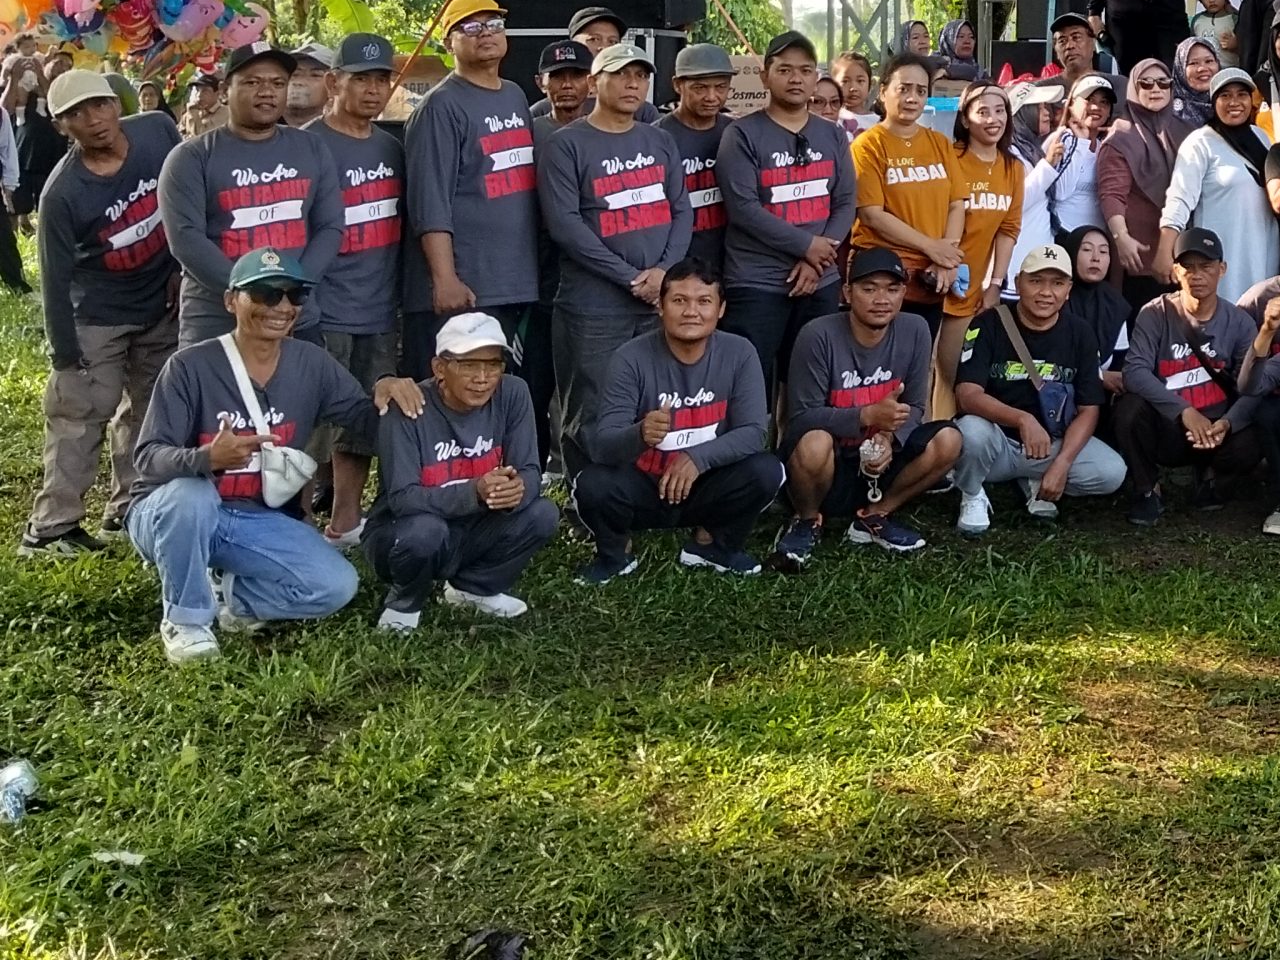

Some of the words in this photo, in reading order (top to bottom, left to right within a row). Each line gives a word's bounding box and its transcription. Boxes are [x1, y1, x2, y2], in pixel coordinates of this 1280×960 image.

[727, 87, 768, 100] Cosmos
[484, 115, 503, 132] We
[602, 156, 624, 175] We
[625, 152, 655, 169] Are
[682, 156, 704, 174] We
[772, 150, 795, 167] We
[896, 157, 916, 166] LOVE
[231, 167, 259, 187] We
[261, 163, 298, 183] Are
[346, 167, 366, 186] We
[367, 161, 394, 180] Are
[105, 199, 129, 221] We
[129, 178, 158, 202] Are
[793, 184, 808, 198] OF
[259, 206, 279, 221] OF
[368, 203, 383, 218] OF
[1043, 246, 1058, 261] LA
[1171, 343, 1193, 359] We
[841, 370, 862, 389] We
[863, 366, 893, 386] Are
[1186, 369, 1201, 384] OF
[658, 391, 682, 410] We
[684, 387, 715, 407] Are
[676, 431, 694, 447] OF
[434, 438, 462, 462] We
